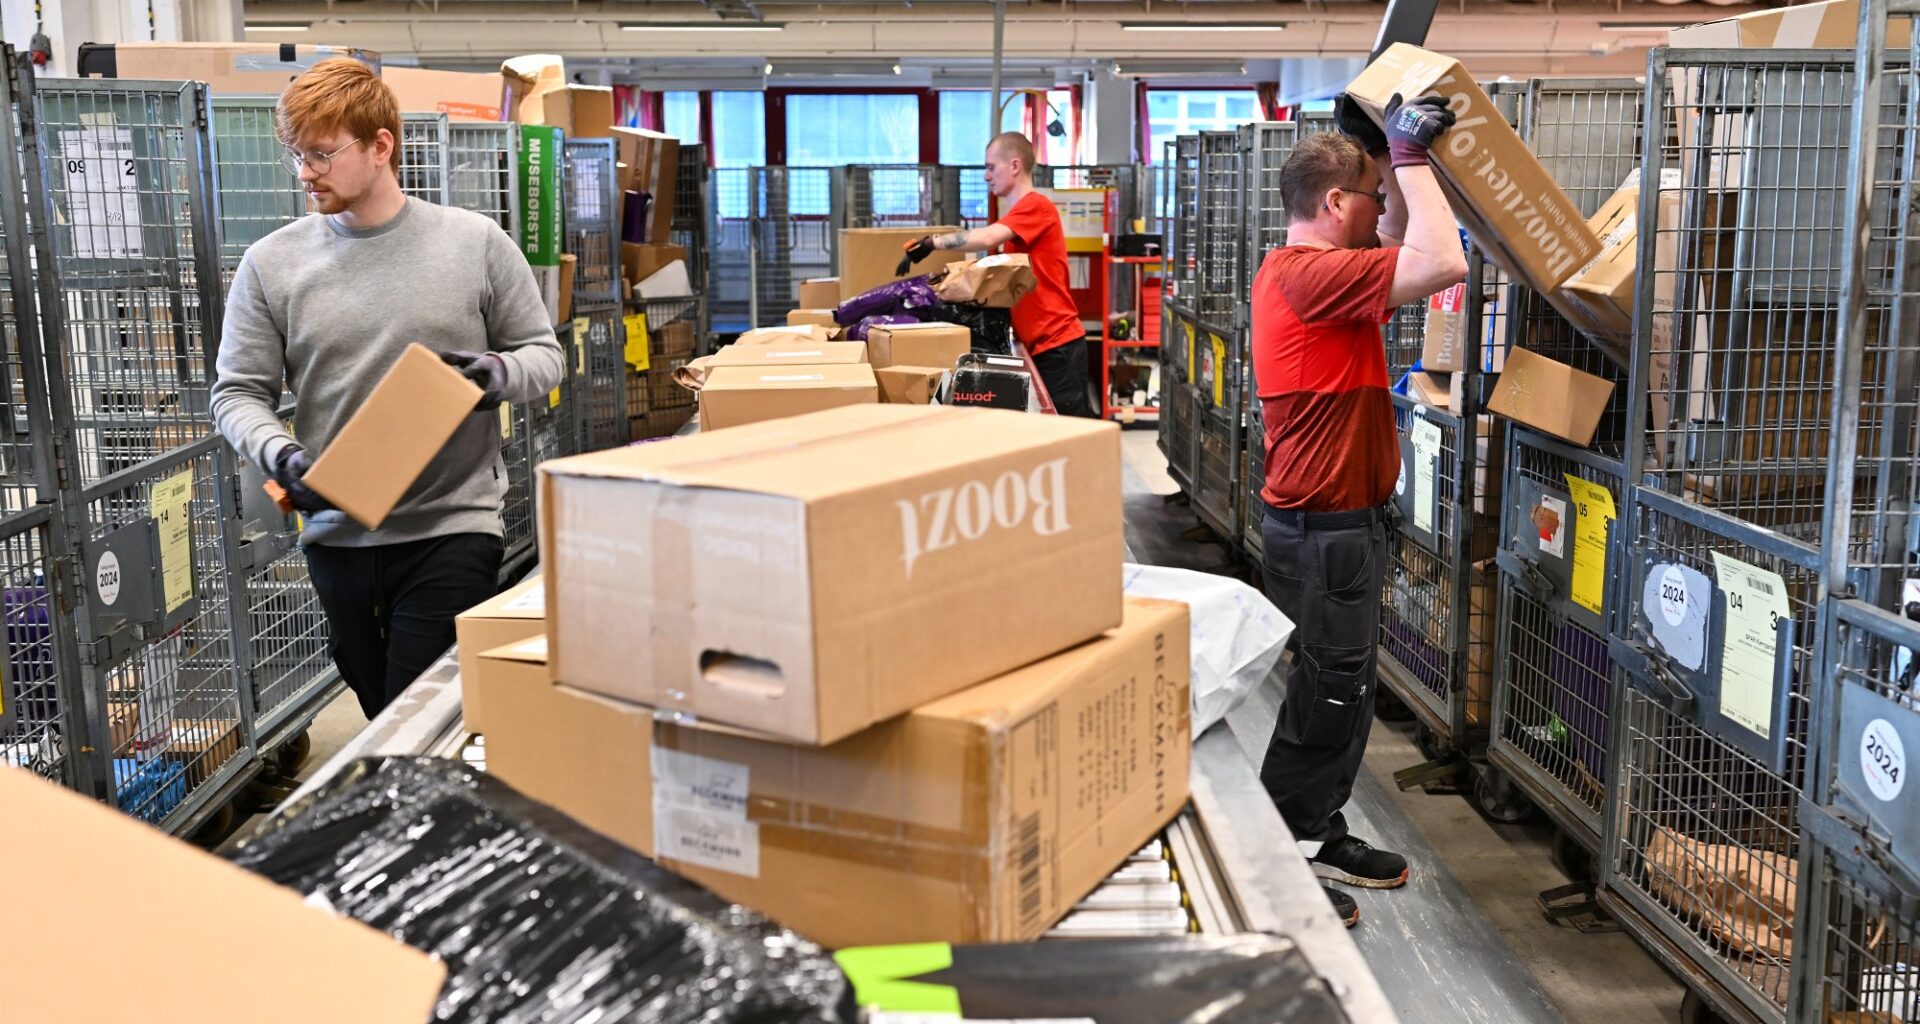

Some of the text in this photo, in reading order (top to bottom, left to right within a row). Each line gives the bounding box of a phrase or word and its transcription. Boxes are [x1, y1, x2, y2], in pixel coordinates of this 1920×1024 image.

[124, 160, 135, 176] 2
[528, 138, 541, 253] MUSEBØRSTE
[954, 391, 997, 403] point
[160, 502, 188, 524] 14 3
[895, 456, 1072, 582] Boozt
[1579, 502, 1609, 531] 05 3
[100, 570, 118, 587] 2024
[1662, 584, 1685, 604] 2024
[1730, 591, 1778, 631] 04 3
[1866, 734, 1899, 784] 2024
